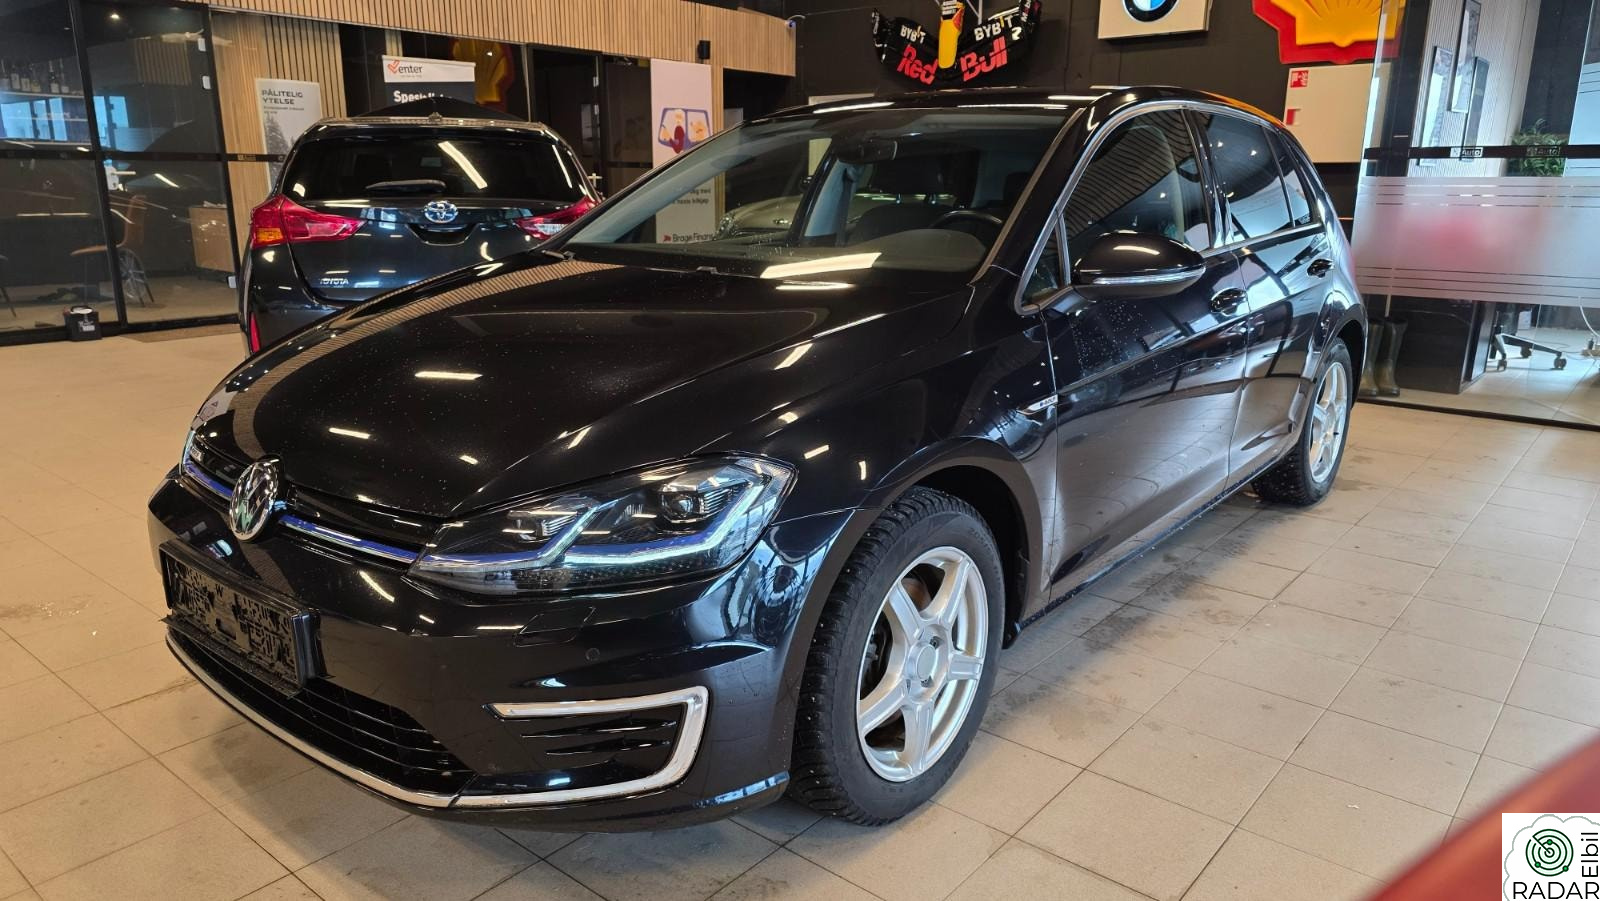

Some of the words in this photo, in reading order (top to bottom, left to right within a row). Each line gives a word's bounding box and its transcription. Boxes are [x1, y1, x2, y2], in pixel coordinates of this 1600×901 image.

[900, 24, 926, 44] BYBIT
[974, 15, 1013, 41] BYBIT
[897, 43, 938, 85] Red
[960, 36, 1008, 82] Bull
[263, 97, 295, 105] YTELSE
[319, 277, 349, 285] TOYOTA
